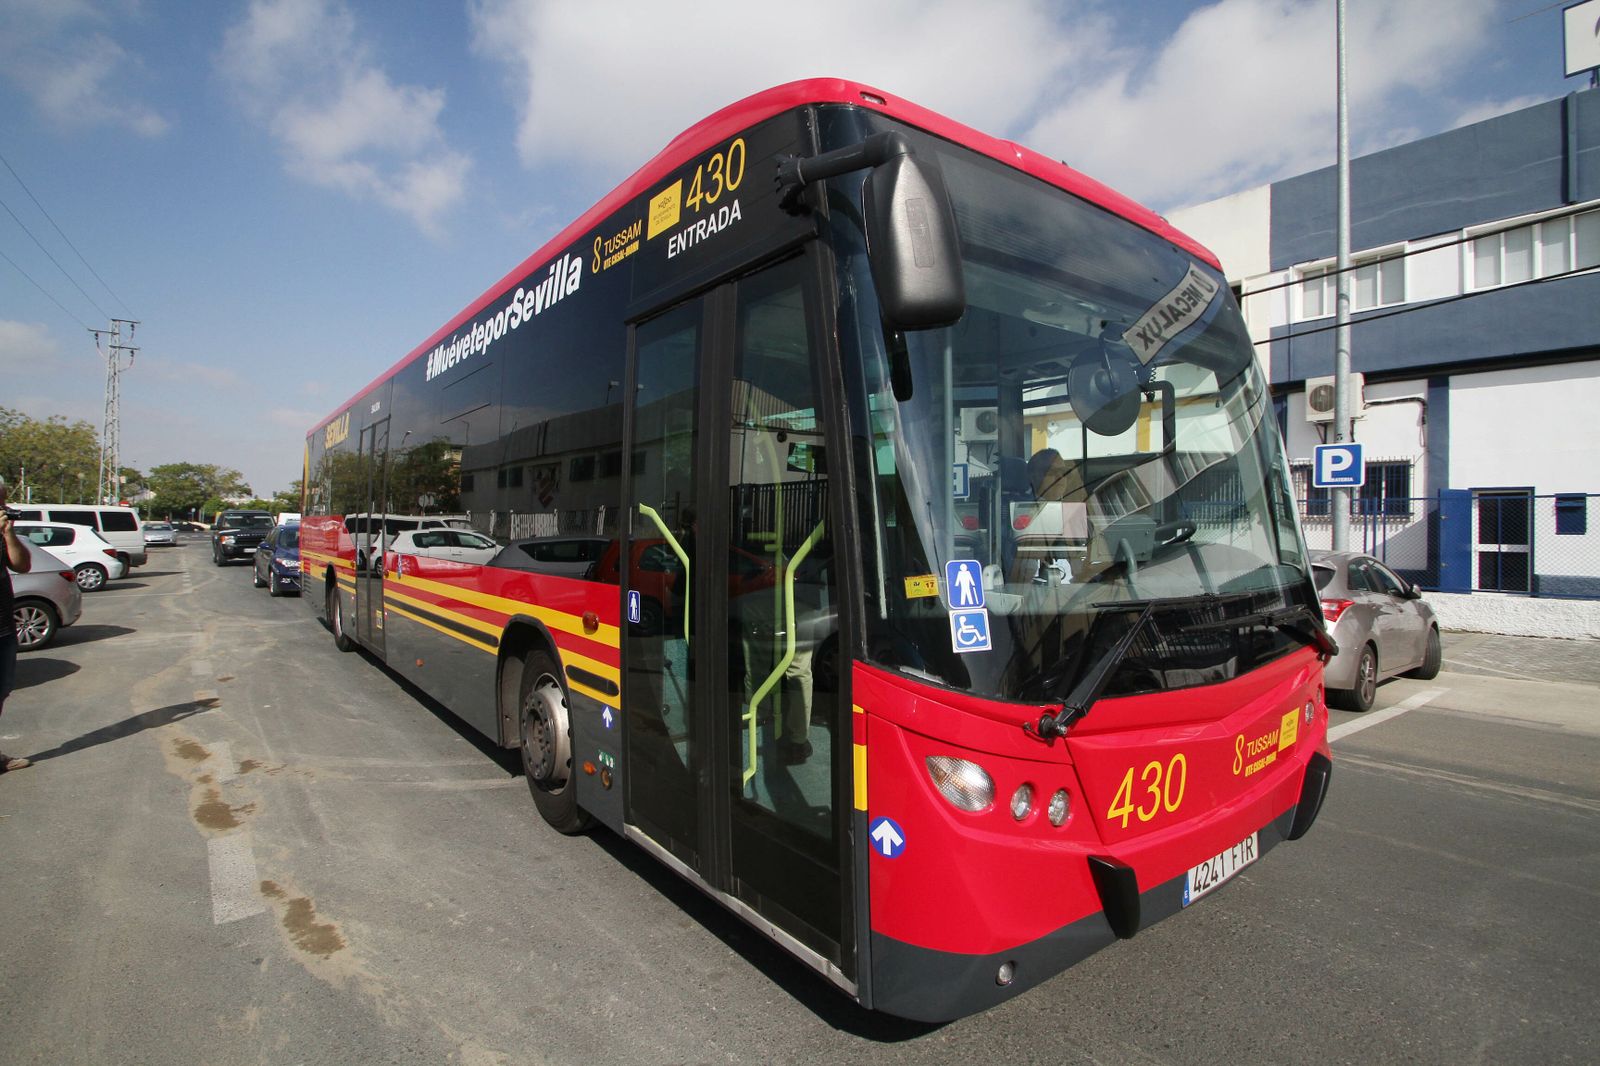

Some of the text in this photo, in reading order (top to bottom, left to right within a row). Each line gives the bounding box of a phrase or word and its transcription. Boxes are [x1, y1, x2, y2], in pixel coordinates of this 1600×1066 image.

[686, 138, 746, 213] 430
[603, 219, 642, 257] TUSSAM
[668, 199, 742, 259] ENTRADA
[426, 253, 583, 382] #MuéveteporSevilla
[1321, 448, 1354, 482] P
[1247, 728, 1279, 758] TUSSAM
[1107, 753, 1187, 829] 430
[1193, 851, 1225, 893] 4241
